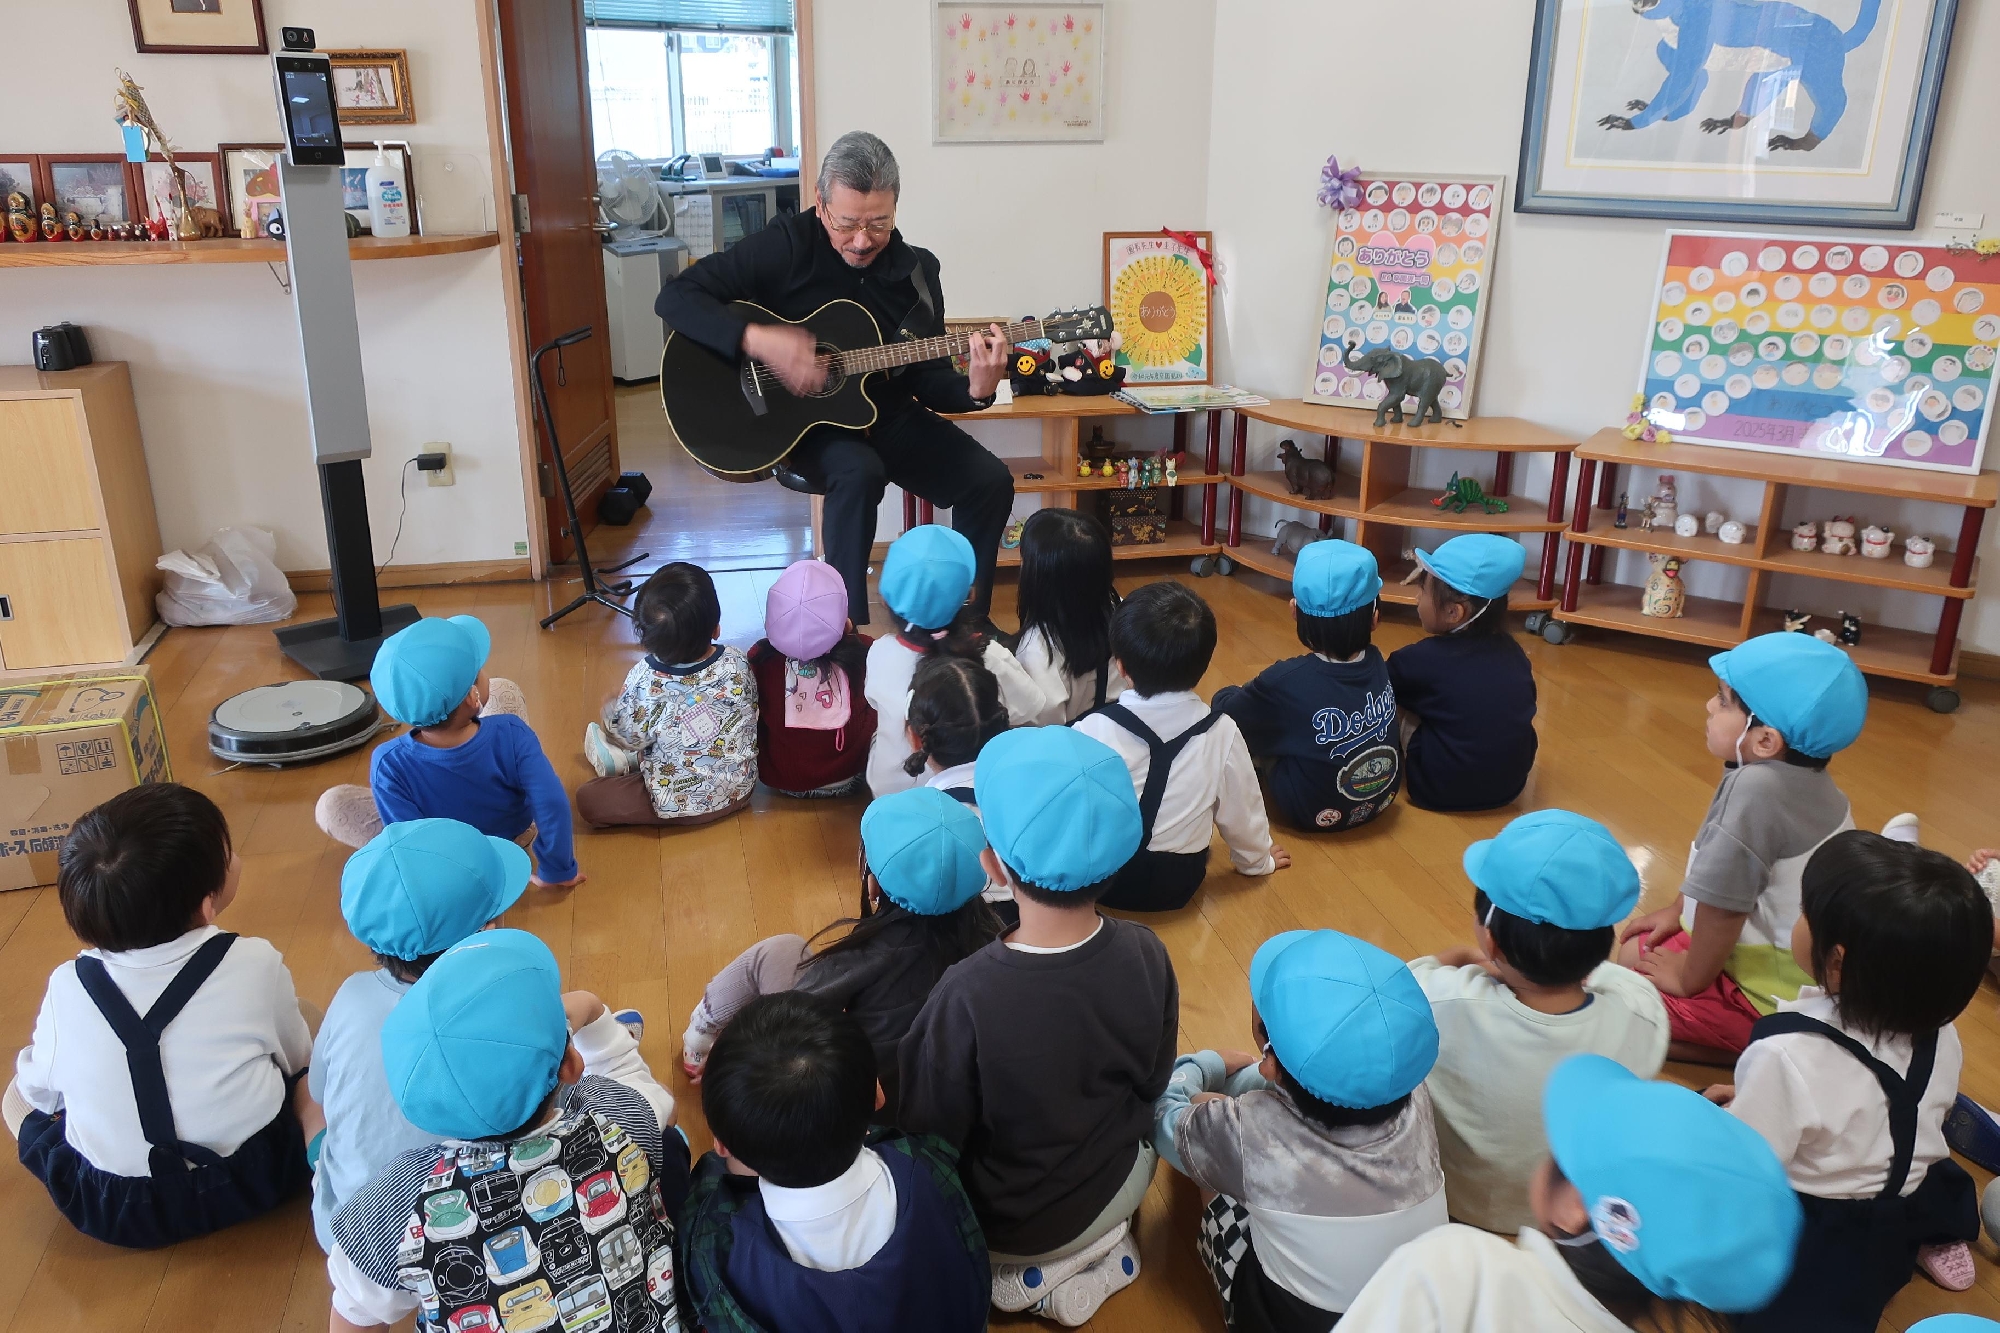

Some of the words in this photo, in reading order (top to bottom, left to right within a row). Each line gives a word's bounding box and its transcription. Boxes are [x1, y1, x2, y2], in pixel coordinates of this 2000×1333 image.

[1358, 246, 1430, 268] ありがとう
[1140, 304, 1176, 319] ありがとう
